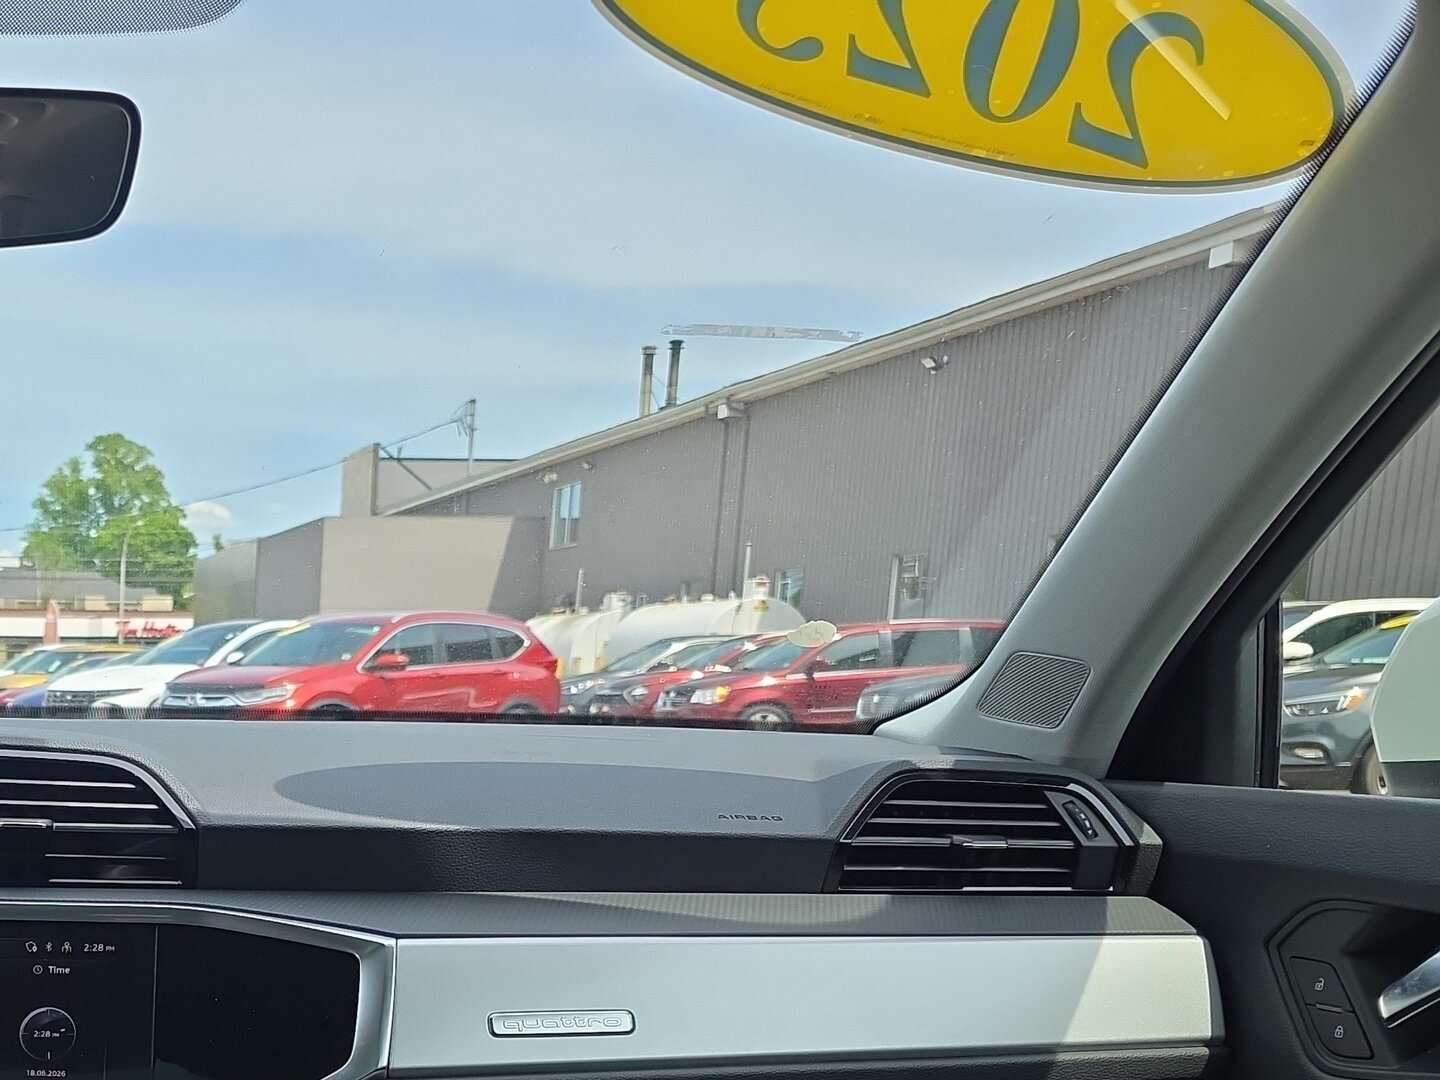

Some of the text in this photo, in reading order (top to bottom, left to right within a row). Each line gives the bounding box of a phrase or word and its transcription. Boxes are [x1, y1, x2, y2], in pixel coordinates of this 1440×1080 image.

[718, 812, 784, 823] AIRBAG
[83, 943, 104, 952] 2:28
[47, 964, 71, 975] Time
[502, 1015, 623, 1032] quattro
[33, 1029, 51, 1038] 2:28
